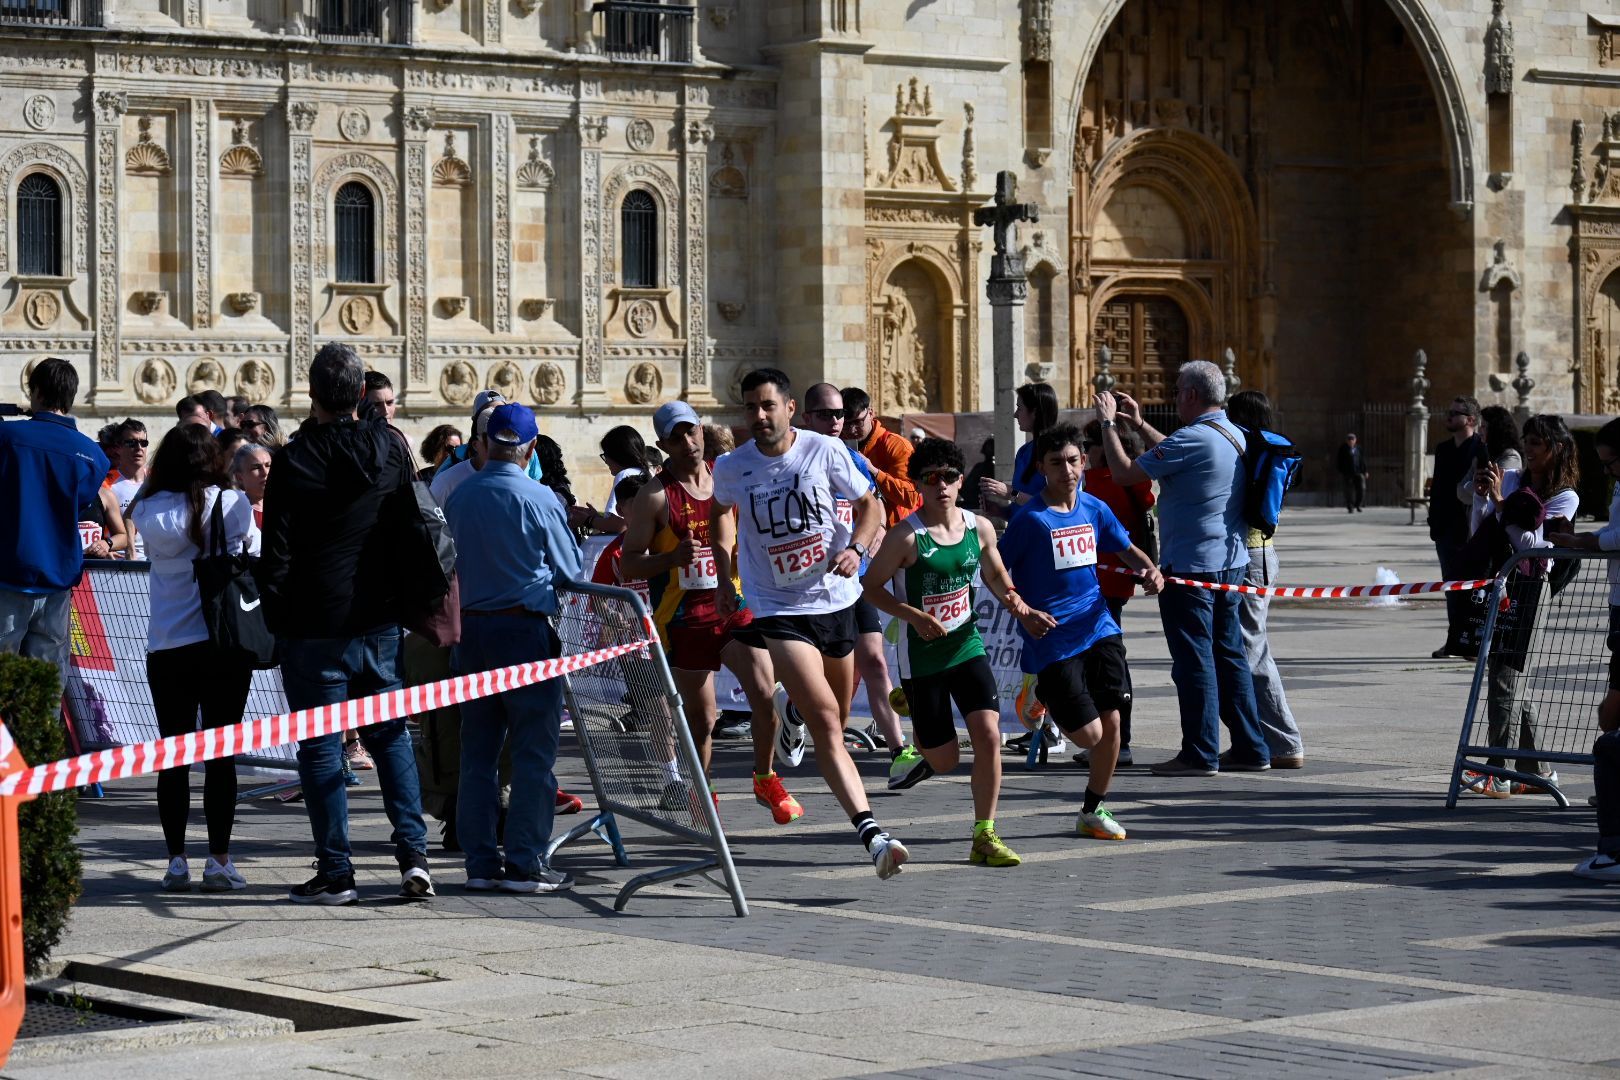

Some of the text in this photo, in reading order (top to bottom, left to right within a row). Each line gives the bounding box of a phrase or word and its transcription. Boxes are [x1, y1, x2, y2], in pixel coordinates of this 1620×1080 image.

[750, 473, 824, 539] LEÓN
[837, 509, 851, 525] 74
[83, 531, 100, 545] 16
[1056, 535, 1095, 558] 1104
[681, 560, 717, 578] 118
[774, 544, 825, 575] 1235
[928, 595, 968, 622] 1264
